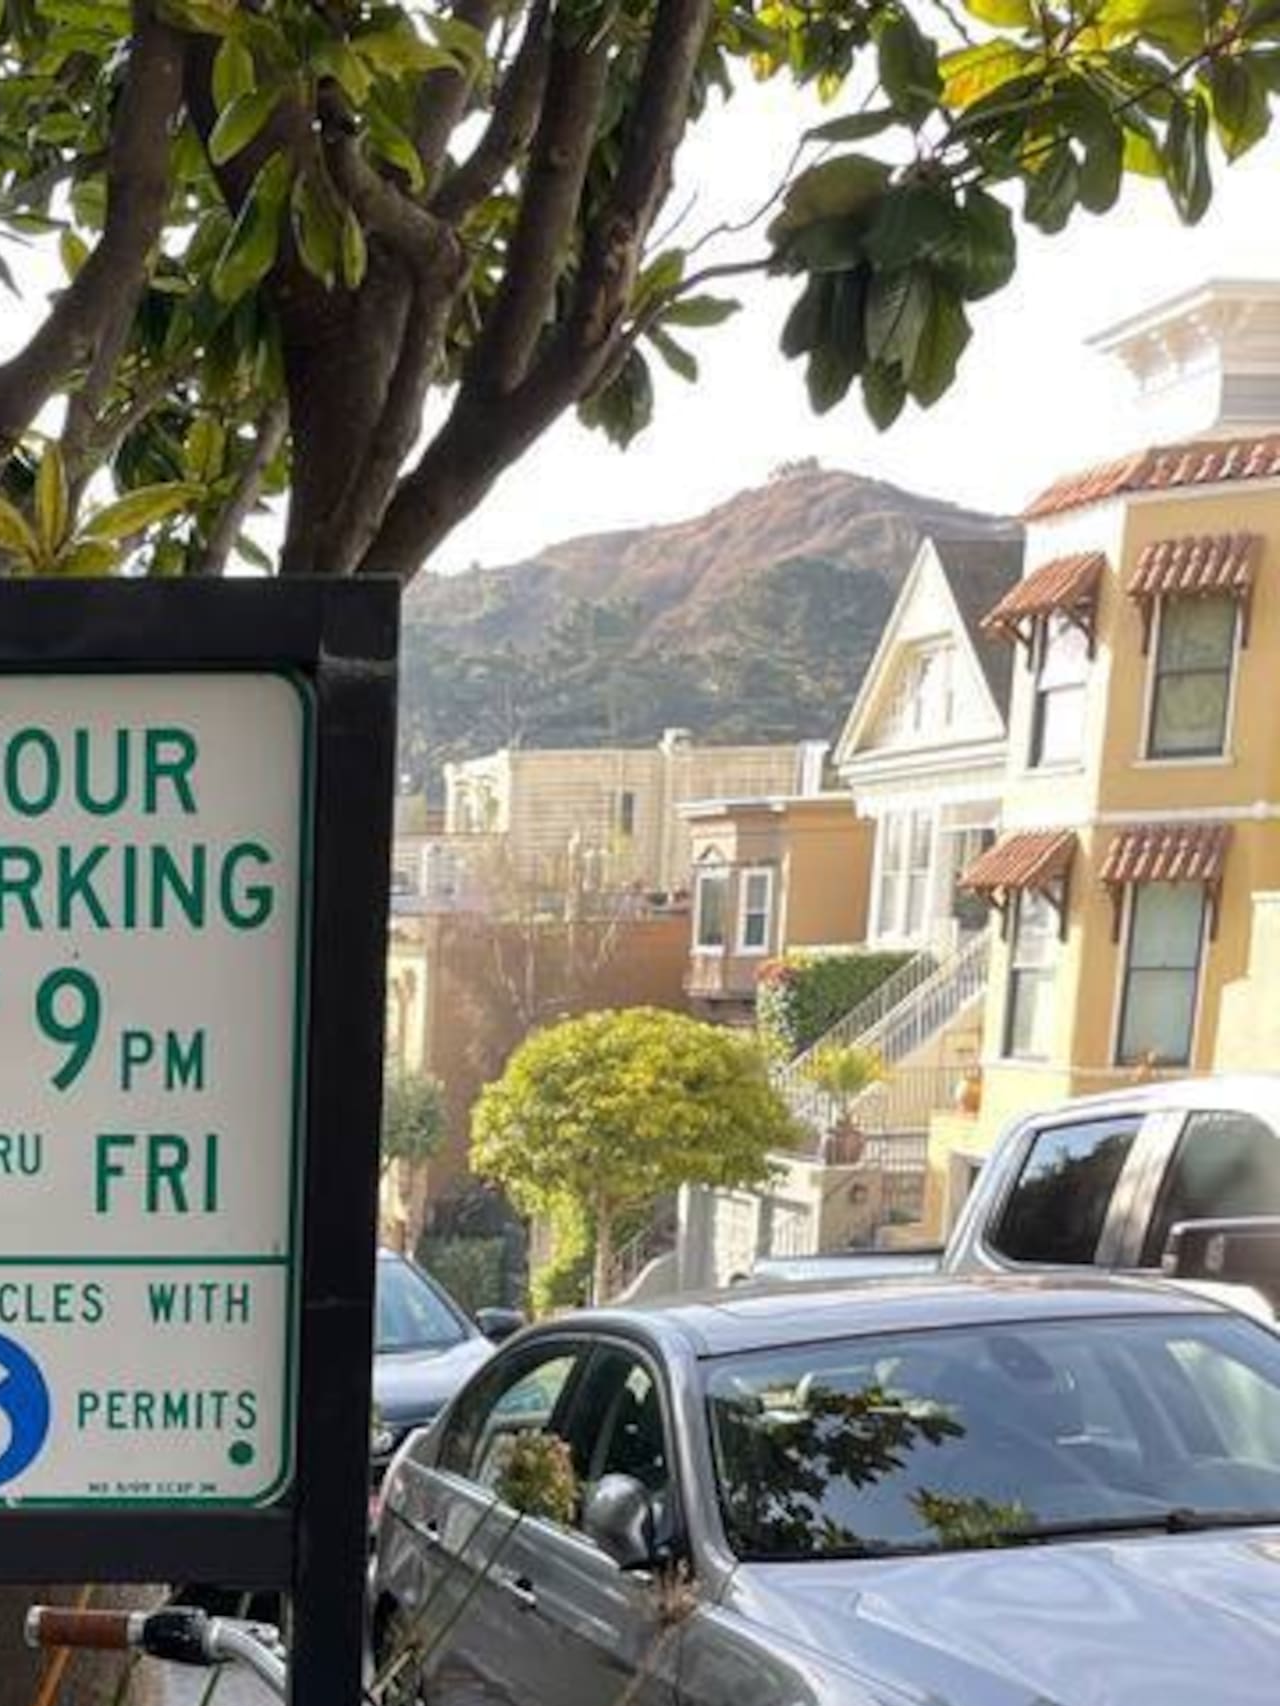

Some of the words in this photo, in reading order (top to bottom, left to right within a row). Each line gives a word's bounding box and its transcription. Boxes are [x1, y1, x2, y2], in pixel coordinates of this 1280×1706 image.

[95, 1133, 219, 1213] FRI
[148, 1282, 250, 1323] WITH
[77, 1390, 257, 1431] PERMITS
